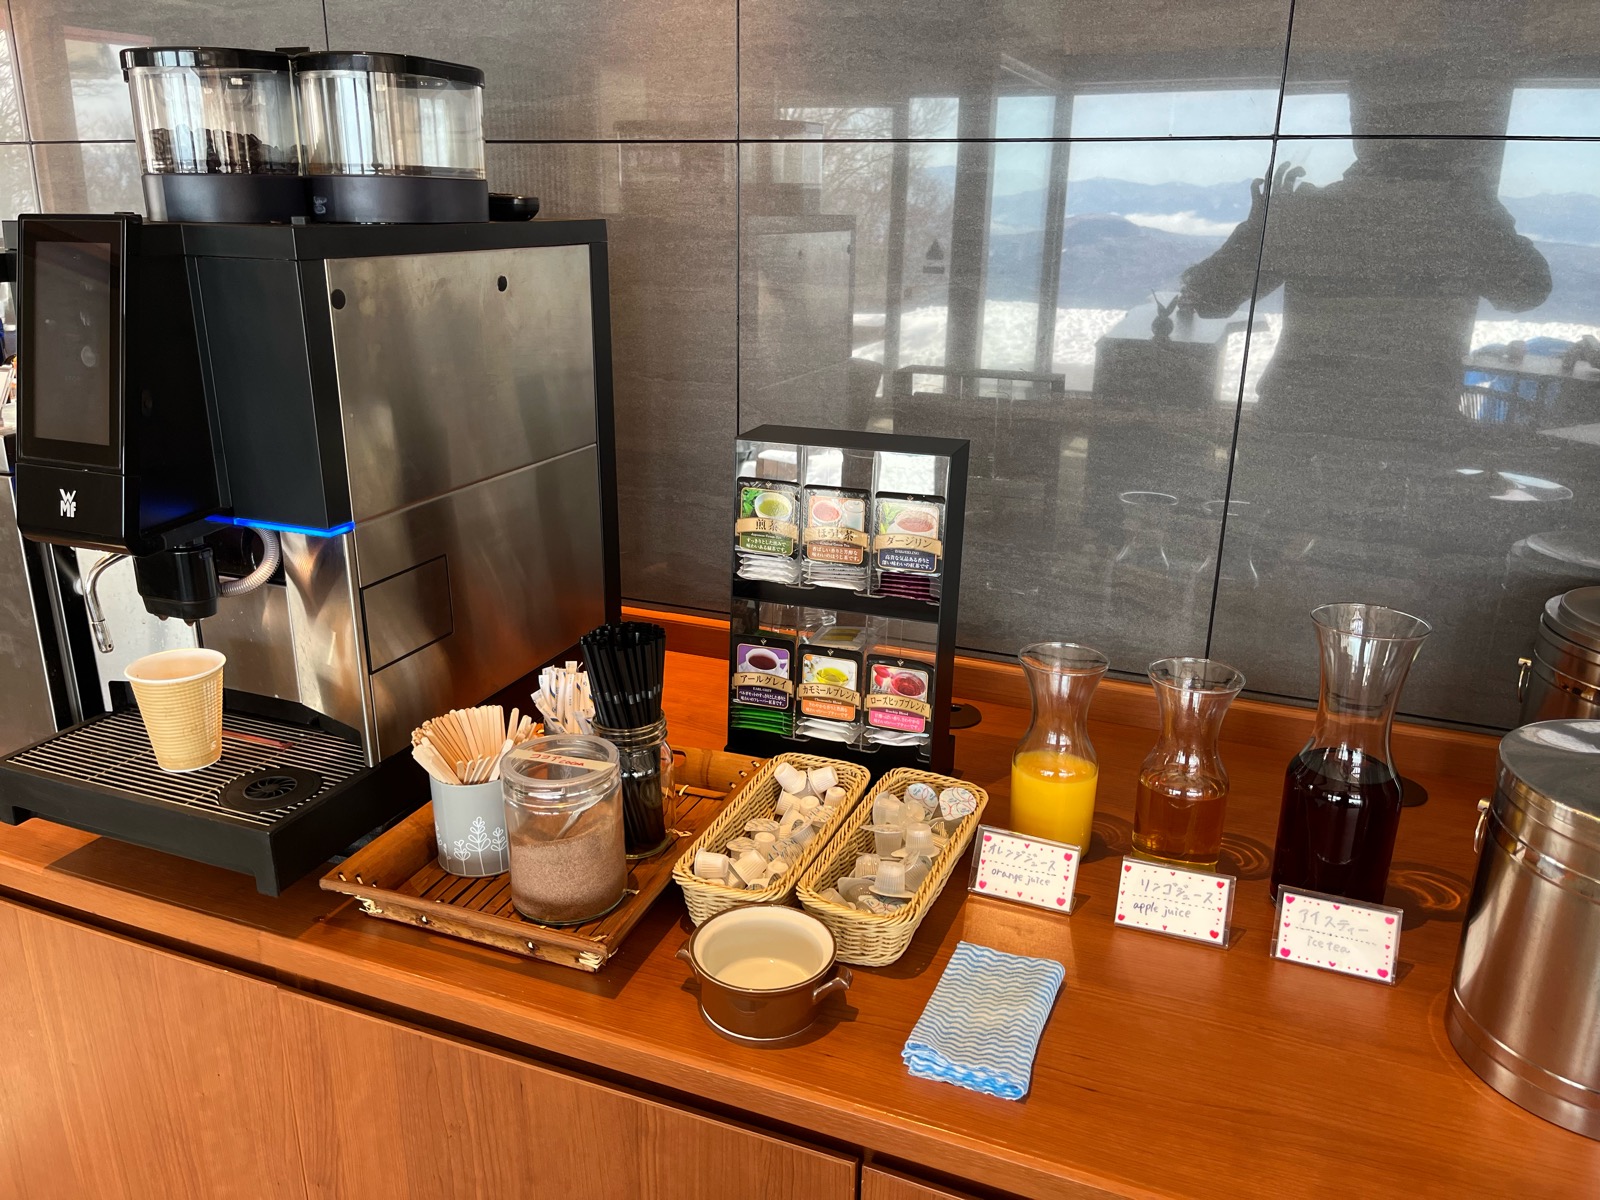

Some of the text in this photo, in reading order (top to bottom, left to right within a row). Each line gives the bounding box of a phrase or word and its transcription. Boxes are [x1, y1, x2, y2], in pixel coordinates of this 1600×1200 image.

[59, 488, 77, 518] WMF
[755, 518, 778, 532] 煎茶
[817, 528, 854, 541] ほうじ茶
[887, 535, 932, 548] ダージリン
[740, 675, 787, 689] アールグレイ
[802, 685, 858, 701] カモミールブレンド
[870, 696, 927, 713] ローズヒップブレンド
[530, 753, 561, 763] ココア
[988, 843, 1056, 872] オレンジジュース
[991, 868, 1051, 886] orange juice
[1141, 878, 1214, 905] リンゴジュース
[1133, 902, 1191, 918] apple juice
[1298, 908, 1369, 935] アイスティー
[1326, 941, 1351, 954] tea
